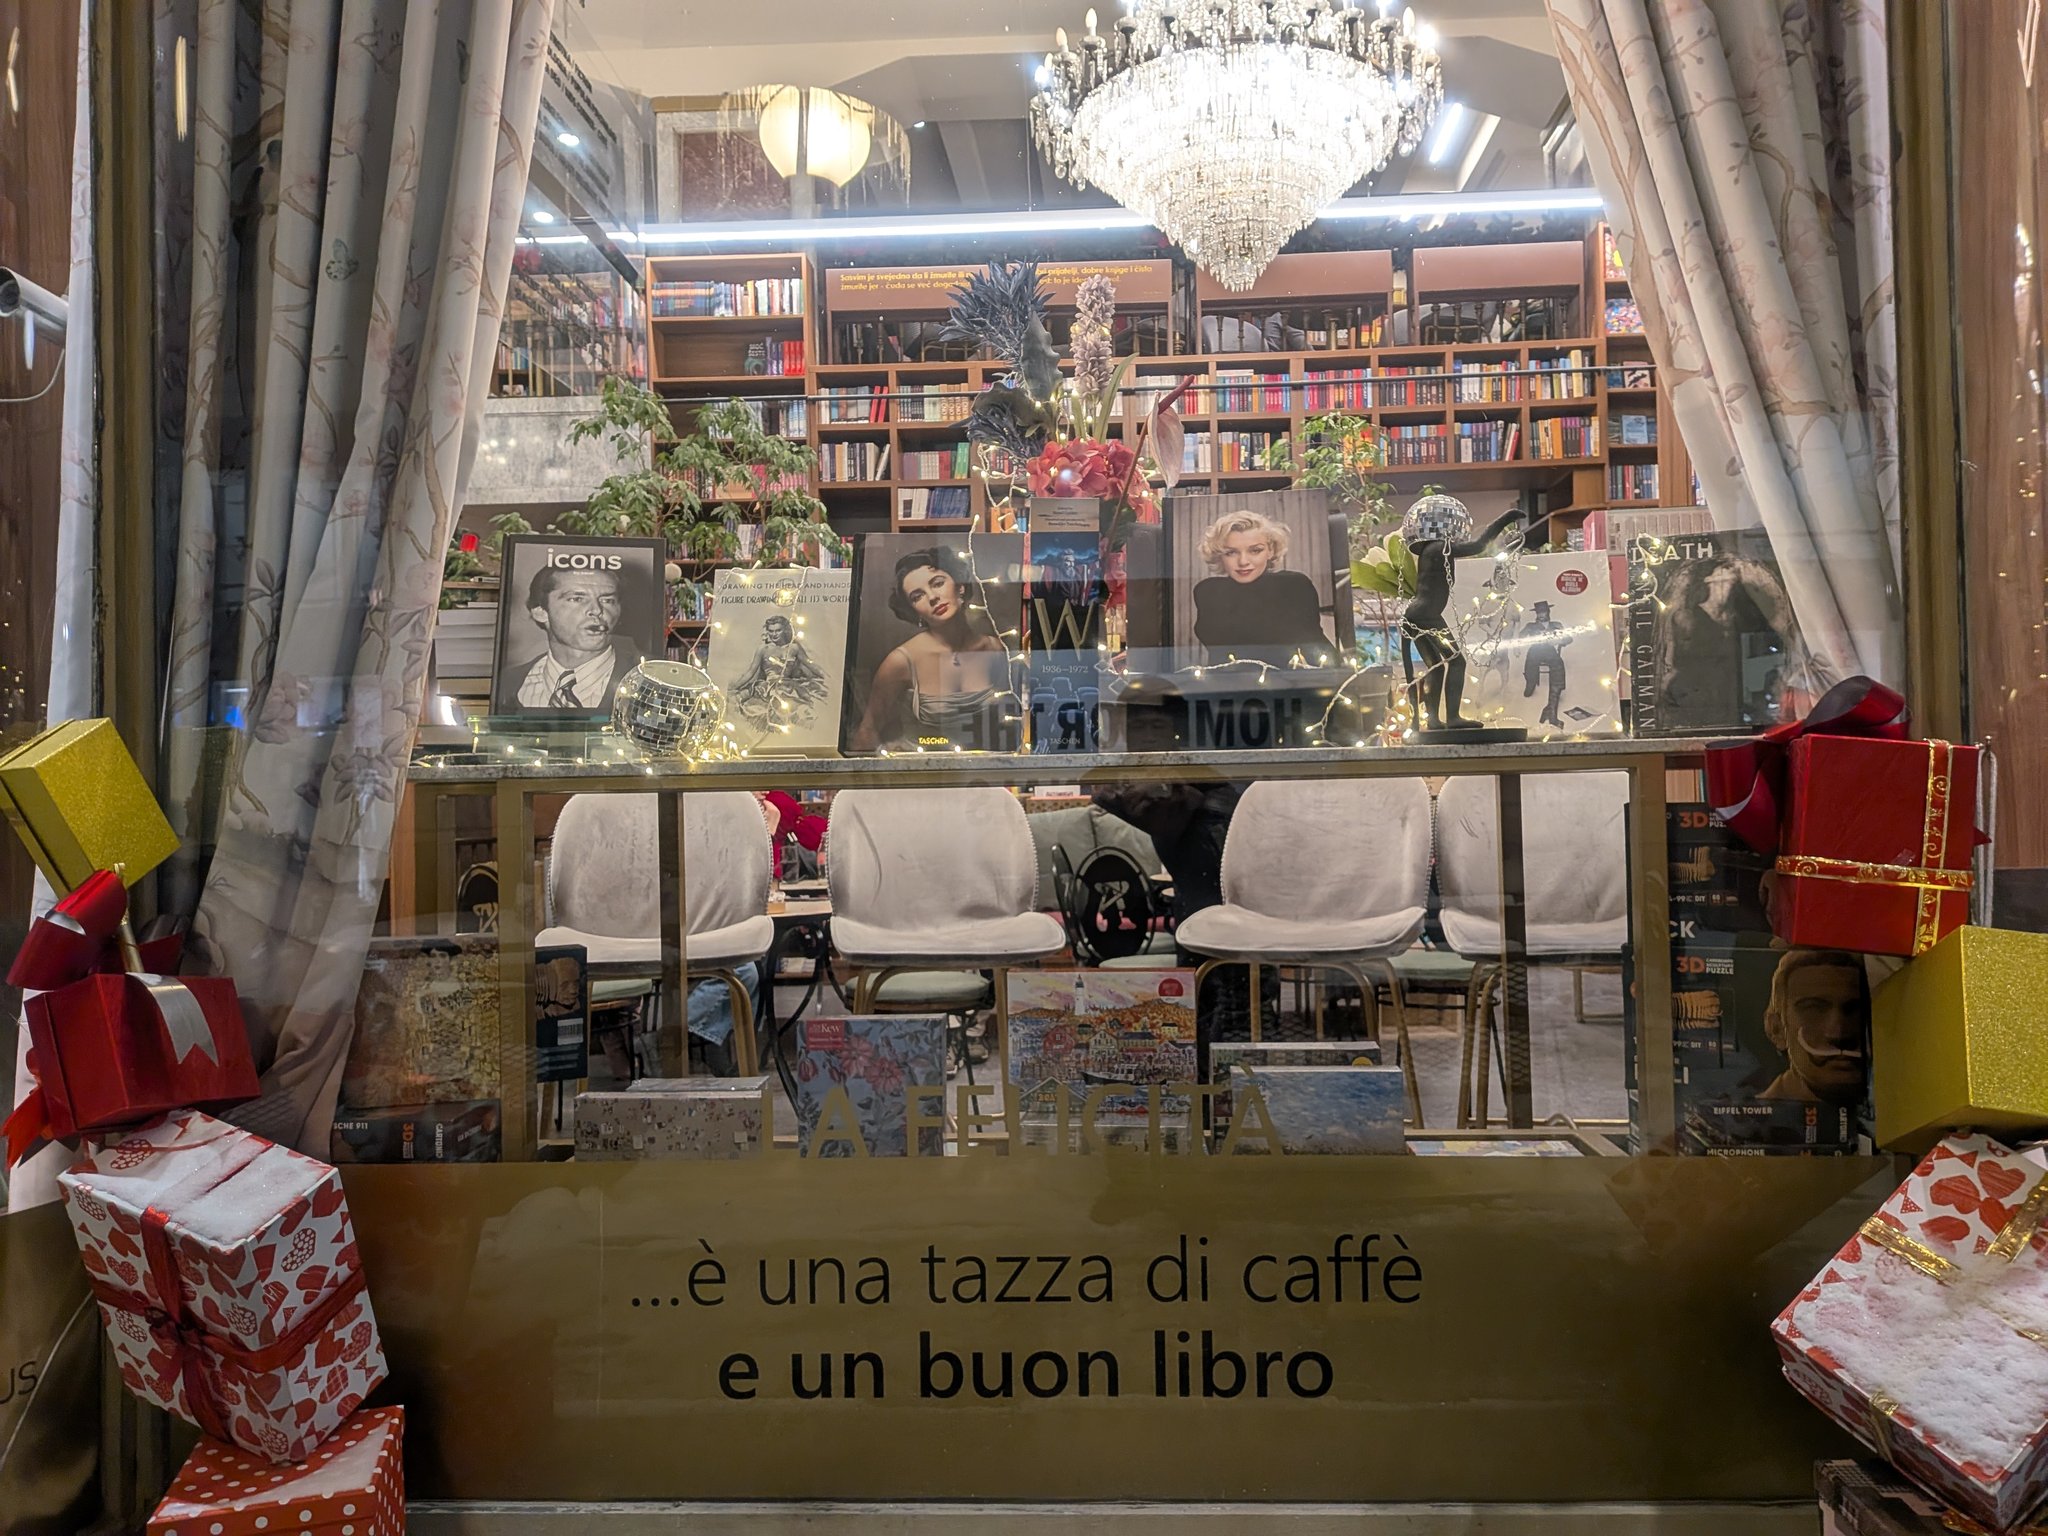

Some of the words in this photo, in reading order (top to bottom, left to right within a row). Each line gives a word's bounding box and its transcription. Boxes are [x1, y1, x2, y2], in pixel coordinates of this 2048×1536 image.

[1081, 266, 1104, 274] dobre
[1105, 266, 1129, 275] knjige
[867, 274, 875, 282] je
[876, 273, 911, 282] svejedno
[912, 272, 923, 280] da
[1063, 277, 1071, 285] je
[869, 283, 879, 291] jer
[547, 548, 622, 570] icons
[721, 595, 744, 604] FIGURE
[1034, 598, 1096, 661] W
[1636, 645, 1656, 729] GAIMAN
[918, 736, 949, 745] TASCHEN
[1680, 811, 1708, 828] 3D
[1677, 956, 1705, 973] 3D
[821, 1024, 841, 1033] Kew
[763, 1085, 870, 1157] LA
[906, 1063, 1284, 1156] FELICITÀ
[1713, 1106, 1741, 1115] EIFFEL
[1742, 1106, 1773, 1115] TOWER
[332, 1122, 354, 1130] SCHE
[355, 1122, 369, 1130] 911
[1706, 1148, 1766, 1156] MICROPHONE
[759, 1255, 891, 1305] una
[921, 1245, 1113, 1303] tazza
[1146, 1234, 1209, 1302] di
[1243, 1232, 1422, 1302] caffè
[718, 1351, 760, 1399] e
[791, 1351, 885, 1399] un
[920, 1331, 1119, 1398] buon
[1155, 1329, 1335, 1398] libro
